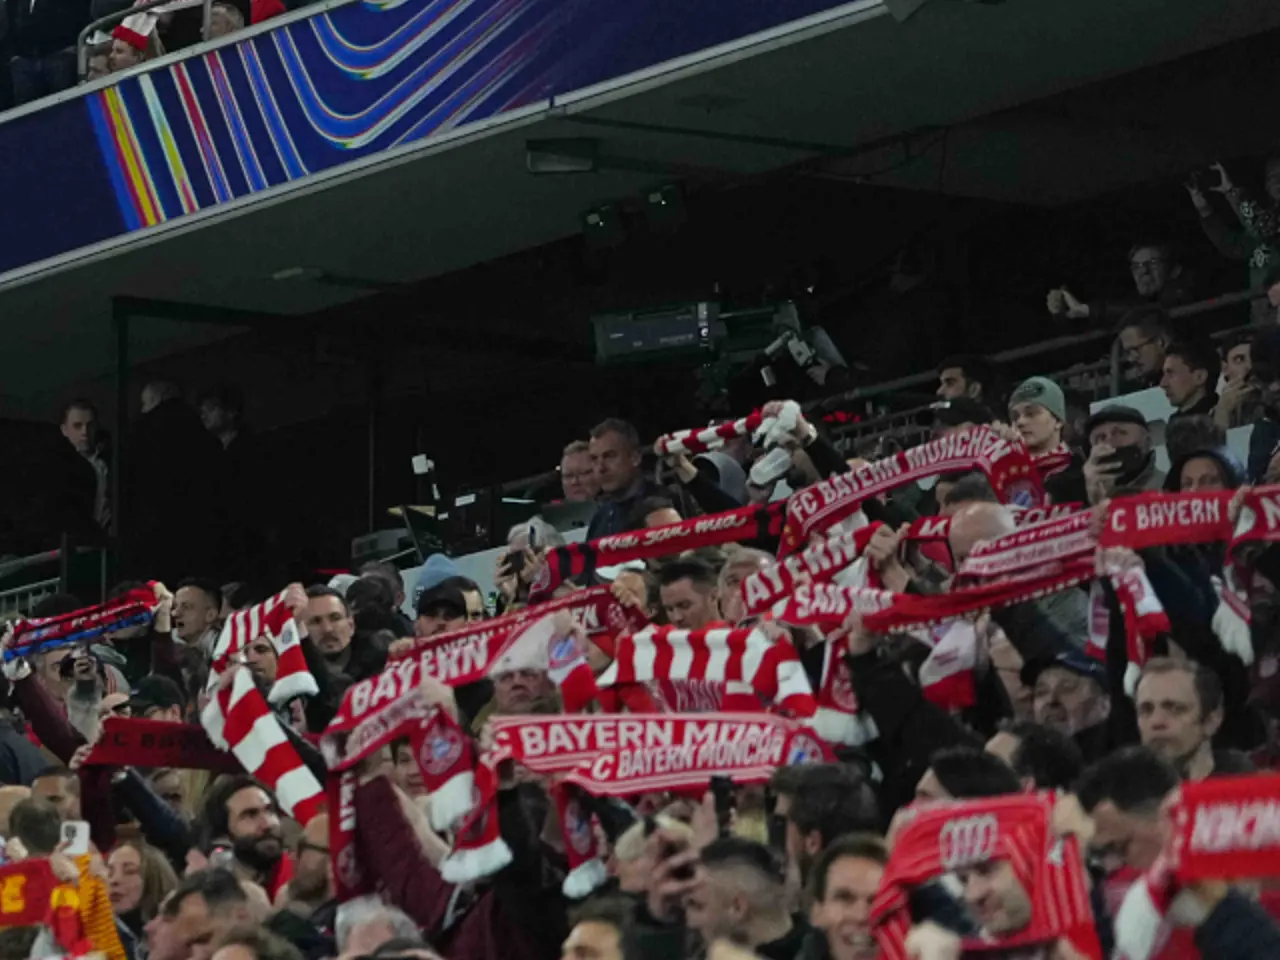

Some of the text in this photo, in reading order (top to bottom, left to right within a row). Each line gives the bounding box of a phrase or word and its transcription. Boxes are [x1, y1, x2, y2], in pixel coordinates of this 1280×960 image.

[821, 453, 900, 503] BAYERN
[1137, 498, 1219, 528] BAYERN
[745, 532, 856, 607] AYERN
[518, 722, 673, 754] BAYERN
